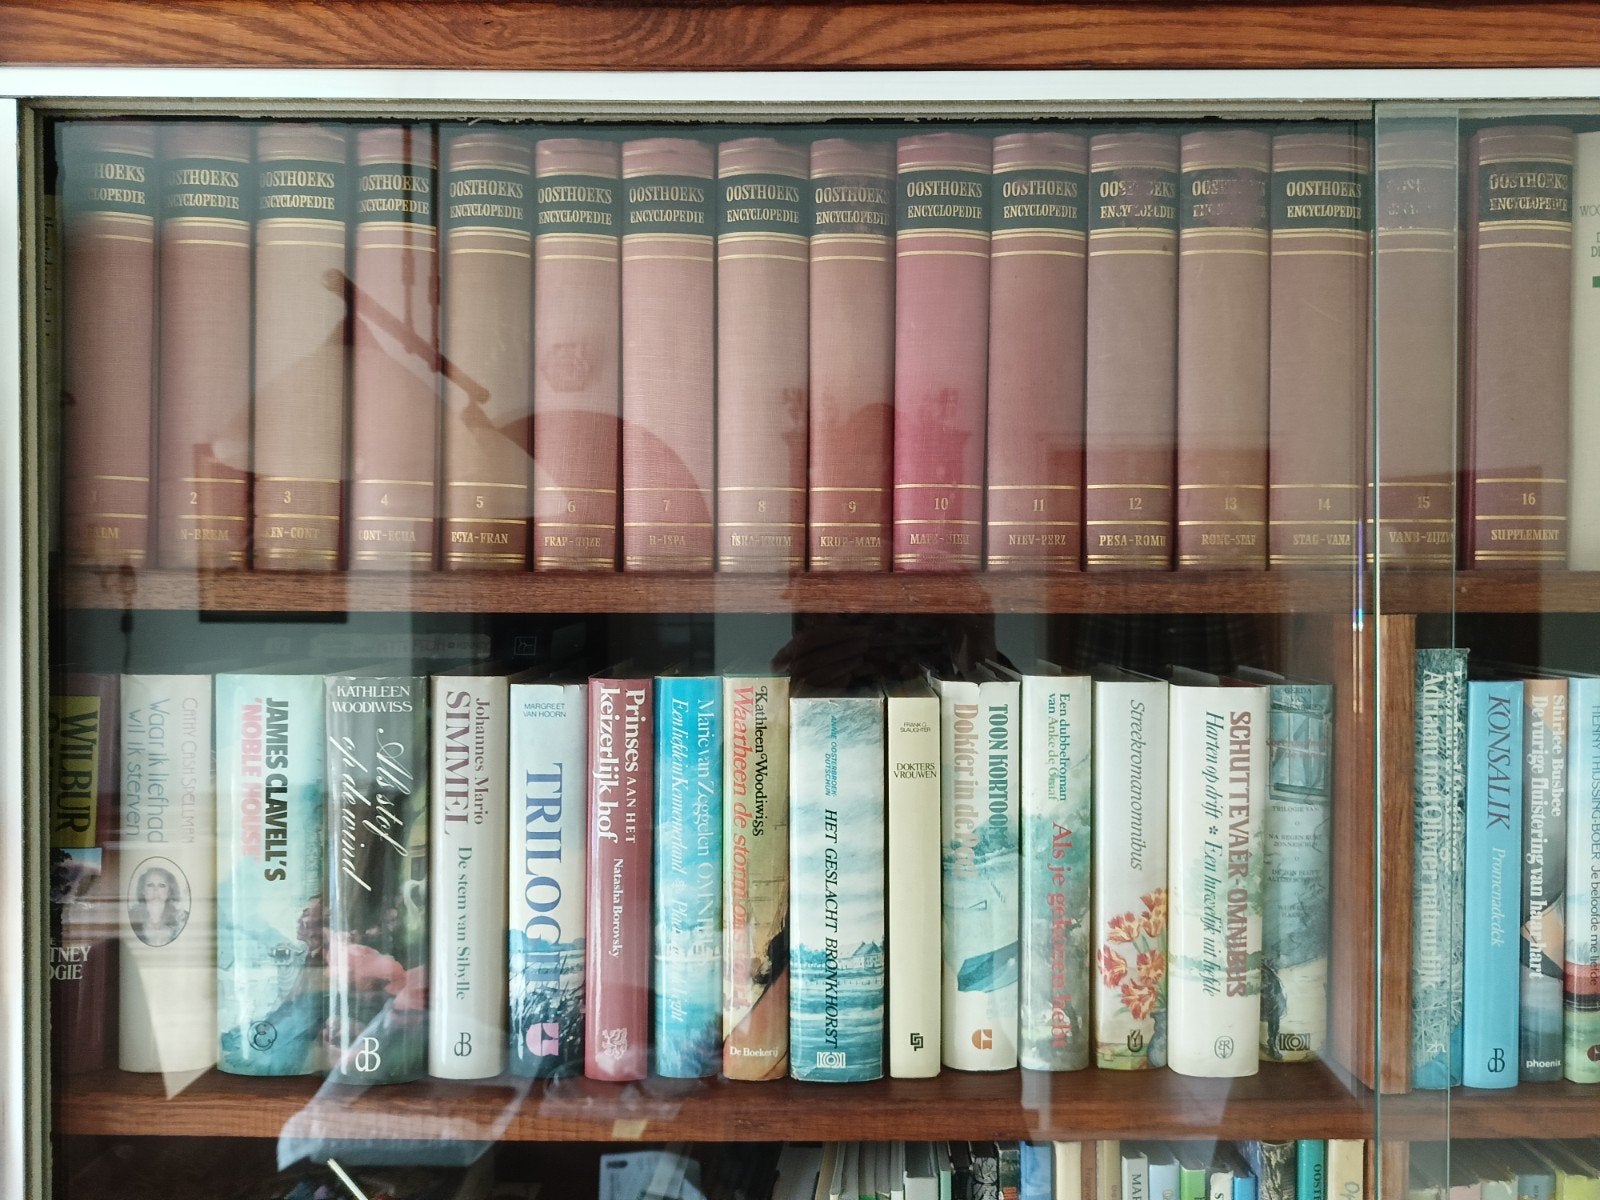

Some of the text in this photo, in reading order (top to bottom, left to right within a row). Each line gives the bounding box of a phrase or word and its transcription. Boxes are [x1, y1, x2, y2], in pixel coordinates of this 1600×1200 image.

[450, 179, 524, 199] OOSTHOEKS
[538, 181, 612, 204] OOSTHOEKS
[630, 186, 705, 203] OOSTHOEKS
[726, 183, 800, 203] OOSTHOEKS
[815, 186, 887, 204] OOSTHOEKS
[907, 181, 982, 199] OOSTHOEKS
[1002, 181, 1078, 199] OOSTHOEKS
[1286, 180, 1362, 197] OOSTHOEKS
[450, 203, 524, 220] ENCYCLOPEDIE
[538, 209, 612, 225] ENCYCLOPEDIE
[630, 209, 705, 225] ENCYCLOPEDIE
[727, 207, 800, 224] ENCYCLOPEDIE
[815, 210, 889, 226] ENCYCLOPEDIE
[907, 205, 982, 220] ENCYCLOPEDIE
[1003, 204, 1078, 219] ENCYCLOPEDIE
[1287, 205, 1362, 220] ENCYCLOPEDIE
[190, 491, 198, 505] 2
[284, 490, 292, 504] 3
[380, 494, 389, 507] 4
[476, 495, 484, 509] 5
[567, 499, 576, 513] 6
[663, 499, 671, 513] 7
[758, 499, 766, 513] 8
[848, 499, 857, 513] 9
[934, 497, 948, 511] 10
[1032, 498, 1045, 512] 11
[1129, 497, 1143, 510] 12
[1224, 498, 1237, 511] 13
[1318, 498, 1331, 511] 14
[1417, 496, 1430, 509] 15
[1522, 493, 1536, 505] 16
[1491, 529, 1559, 541] SUPPLEMENT
[336, 685, 411, 698] KATHLEEN
[1047, 693, 1056, 714] van
[331, 700, 414, 713] WOODIWISS
[523, 702, 566, 710] MARGREET
[671, 697, 690, 725] Een
[1531, 694, 1549, 719] De
[988, 703, 1009, 751] TOON
[1047, 716, 1059, 746] Anke
[1205, 710, 1225, 764] Harten
[668, 725, 689, 761] liefde
[732, 685, 755, 798] Waarheen
[1059, 692, 1071, 801] Een dubbelroman
[1526, 720, 1549, 775] vurige
[180, 740, 198, 775] CASH
[444, 690, 471, 836] SIMMEL
[474, 697, 491, 826] Johannes Mario
[593, 687, 621, 844] keizerlijk hof
[624, 688, 647, 844] Prinses AAN HET
[752, 685, 768, 837] Kathleen Woodiwiss
[896, 762, 936, 771] DOKTERS
[953, 703, 979, 830] Dokter in de
[1046, 748, 1059, 765] de
[1486, 693, 1512, 831] KONSALIK
[1552, 694, 1566, 818] Shirlee Busbee
[56, 711, 98, 833] WILBUR
[692, 699, 716, 857] Marie van Zeggelen
[893, 771, 937, 779] VROUWEN
[1201, 765, 1219, 785] op
[264, 697, 289, 882] JAMES CLAVELL'S
[1129, 699, 1147, 871] Streekromanomnibus
[126, 763, 145, 837] sterven
[1201, 785, 1224, 820] drift
[329, 735, 373, 893] op de wind
[362, 793, 409, 857] stof
[670, 775, 690, 875] Kennemerland
[733, 801, 753, 830] de
[824, 808, 838, 844] HET
[1525, 778, 1549, 865] fluistering
[1052, 823, 1073, 859] Als
[1418, 669, 1446, 989] Adriaan met Olivier natuurlijk
[732, 832, 751, 898] storm
[1204, 839, 1223, 872] Een
[525, 762, 563, 998] TRILOGIE
[1047, 862, 1072, 887] je
[1529, 867, 1545, 897] van
[824, 848, 838, 934] GESLACHT
[1490, 847, 1507, 947] Promenadedek
[609, 858, 624, 960] Natasha Borovsky
[1199, 873, 1222, 935] huwelijk
[454, 846, 472, 1000] De stem van Sibylle
[1046, 891, 1073, 989] gekozen
[1202, 938, 1218, 957] uit
[1529, 943, 1548, 979] hart
[824, 936, 838, 1049] BRONKHORST
[729, 1045, 779, 1059] De Boekerij
[1526, 1058, 1562, 1069] phoenix
